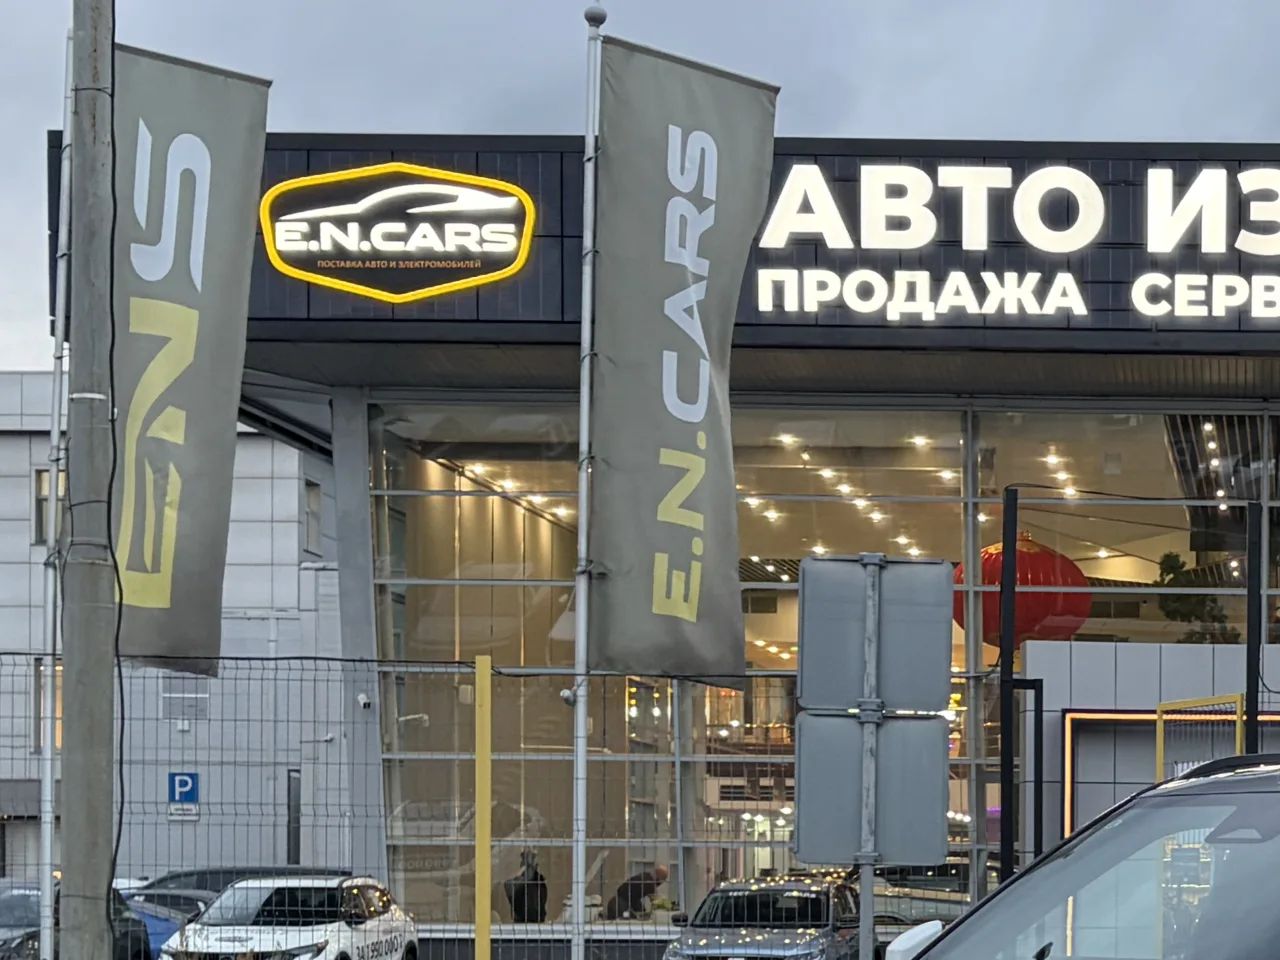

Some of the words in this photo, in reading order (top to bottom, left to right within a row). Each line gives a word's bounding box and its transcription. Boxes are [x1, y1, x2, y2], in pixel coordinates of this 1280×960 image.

[758, 163, 1105, 254] АВТО
[274, 221, 517, 252] E.N.CARS
[317, 259, 363, 269] ПОСТАВКА
[364, 259, 388, 269] АВТО
[389, 259, 397, 269] И
[397, 258, 481, 269] ЭЛЕКТРОМОБИЛЕЙ
[756, 269, 1089, 321] ПРОДАЖА
[652, 123, 719, 624] E.N.CARS
